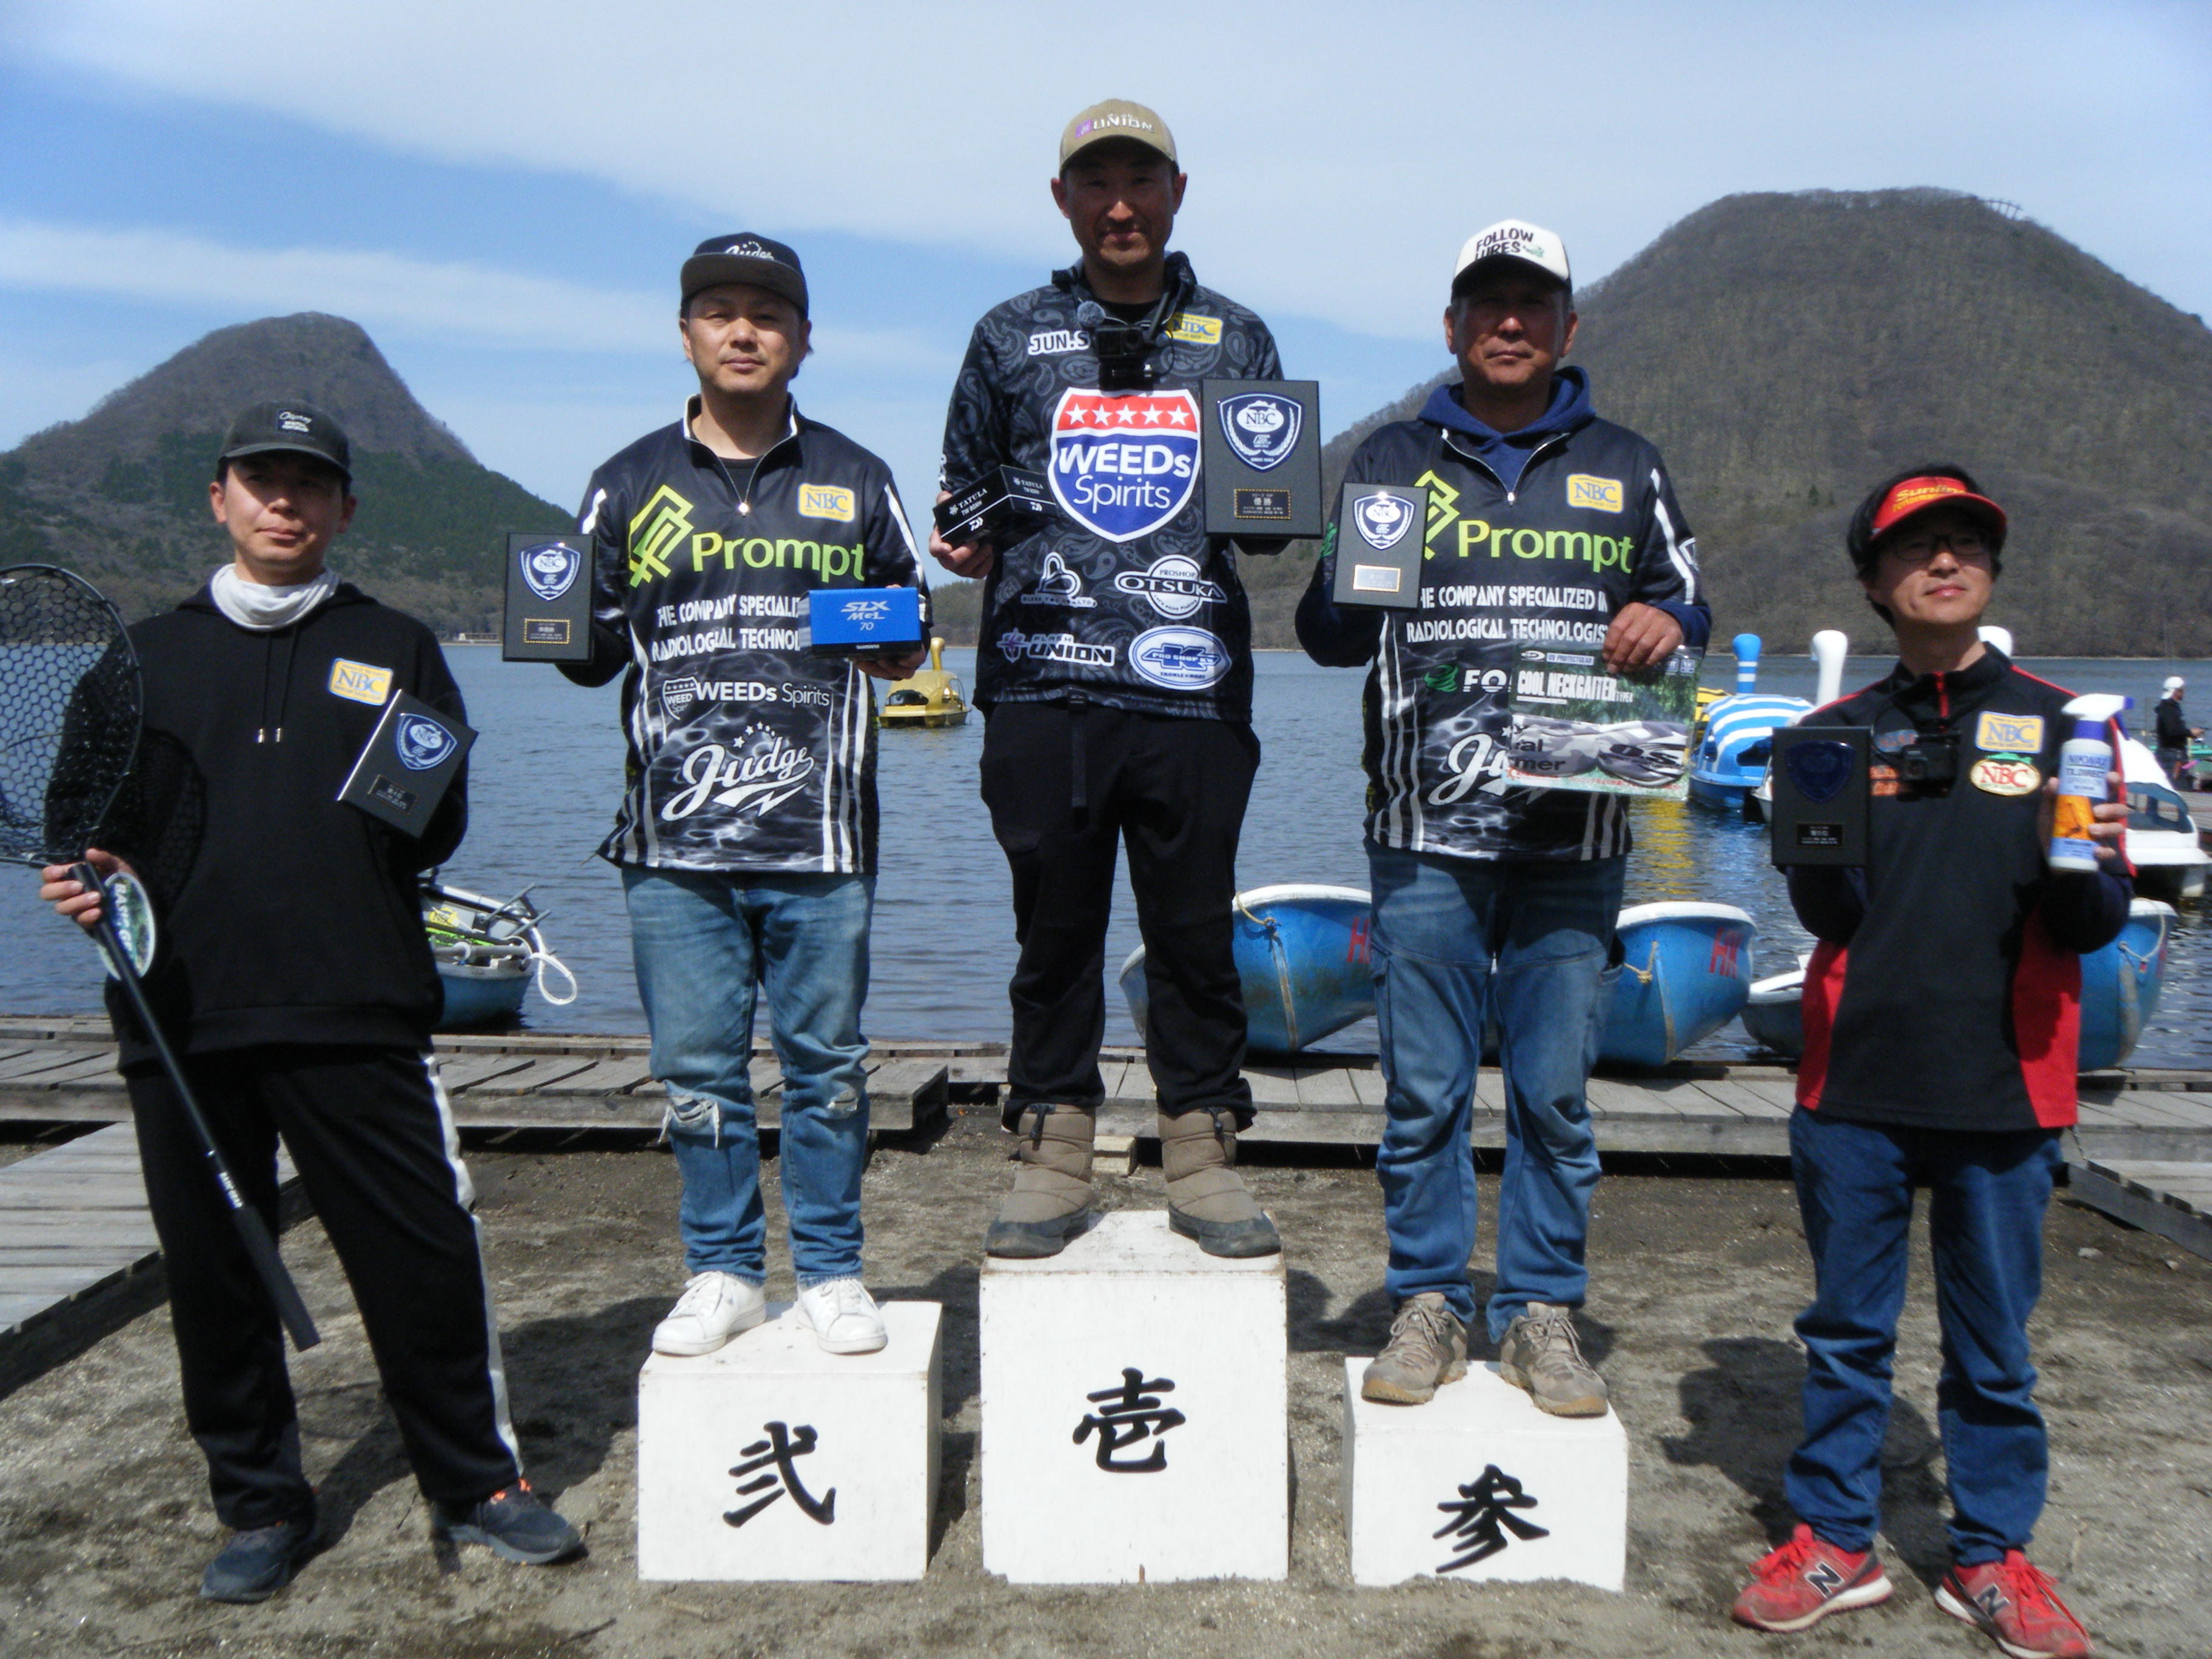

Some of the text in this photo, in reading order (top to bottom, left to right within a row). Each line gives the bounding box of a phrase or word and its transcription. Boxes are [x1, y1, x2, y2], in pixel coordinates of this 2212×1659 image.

[1475, 241, 1521, 261] LURES
[1476, 228, 1533, 252] FOLLOW
[1172, 319, 1216, 336] NBC
[1030, 330, 1090, 354] JUN.S
[1246, 413, 1276, 424] NBC
[1060, 444, 1190, 478] WEEDs
[1021, 480, 1044, 489] TATULA
[1074, 475, 1170, 514] Spirits
[1574, 482, 1617, 503] NBC
[805, 492, 848, 513] NBC
[958, 488, 987, 508] TATULA
[1373, 508, 1394, 517] NBC
[692, 532, 864, 583] Prompt
[1458, 520, 1634, 573] Prompt
[539, 558, 561, 568] NBC
[1159, 569, 1196, 578] PROSHOP
[1119, 577, 1222, 598] OTSUKA
[1419, 588, 1435, 609] HE
[1438, 585, 1506, 607] COMPANY
[1509, 586, 1595, 611] SPECIALIZED
[679, 594, 737, 623] COMPANY
[739, 595, 800, 618] SPECIALI
[840, 601, 891, 612] SLX
[860, 622, 874, 631] 70
[1406, 618, 1506, 643] RADIOLOGICAL
[740, 628, 800, 651] TECHNOL
[1030, 643, 1112, 663] UNION
[335, 668, 384, 695] NBC
[1518, 670, 1544, 696] COOL
[1547, 672, 1617, 702] NECKGAITER
[667, 692, 692, 705] WEED
[696, 681, 830, 708] WEEDs Spirits
[415, 729, 438, 745] NBC
[1986, 721, 2034, 743] NBC
[662, 736, 815, 821] Judge
[1979, 765, 2028, 788] NBC
[1073, 1369, 1185, 1472] 壱
[1434, 1466, 1549, 1573] 参
